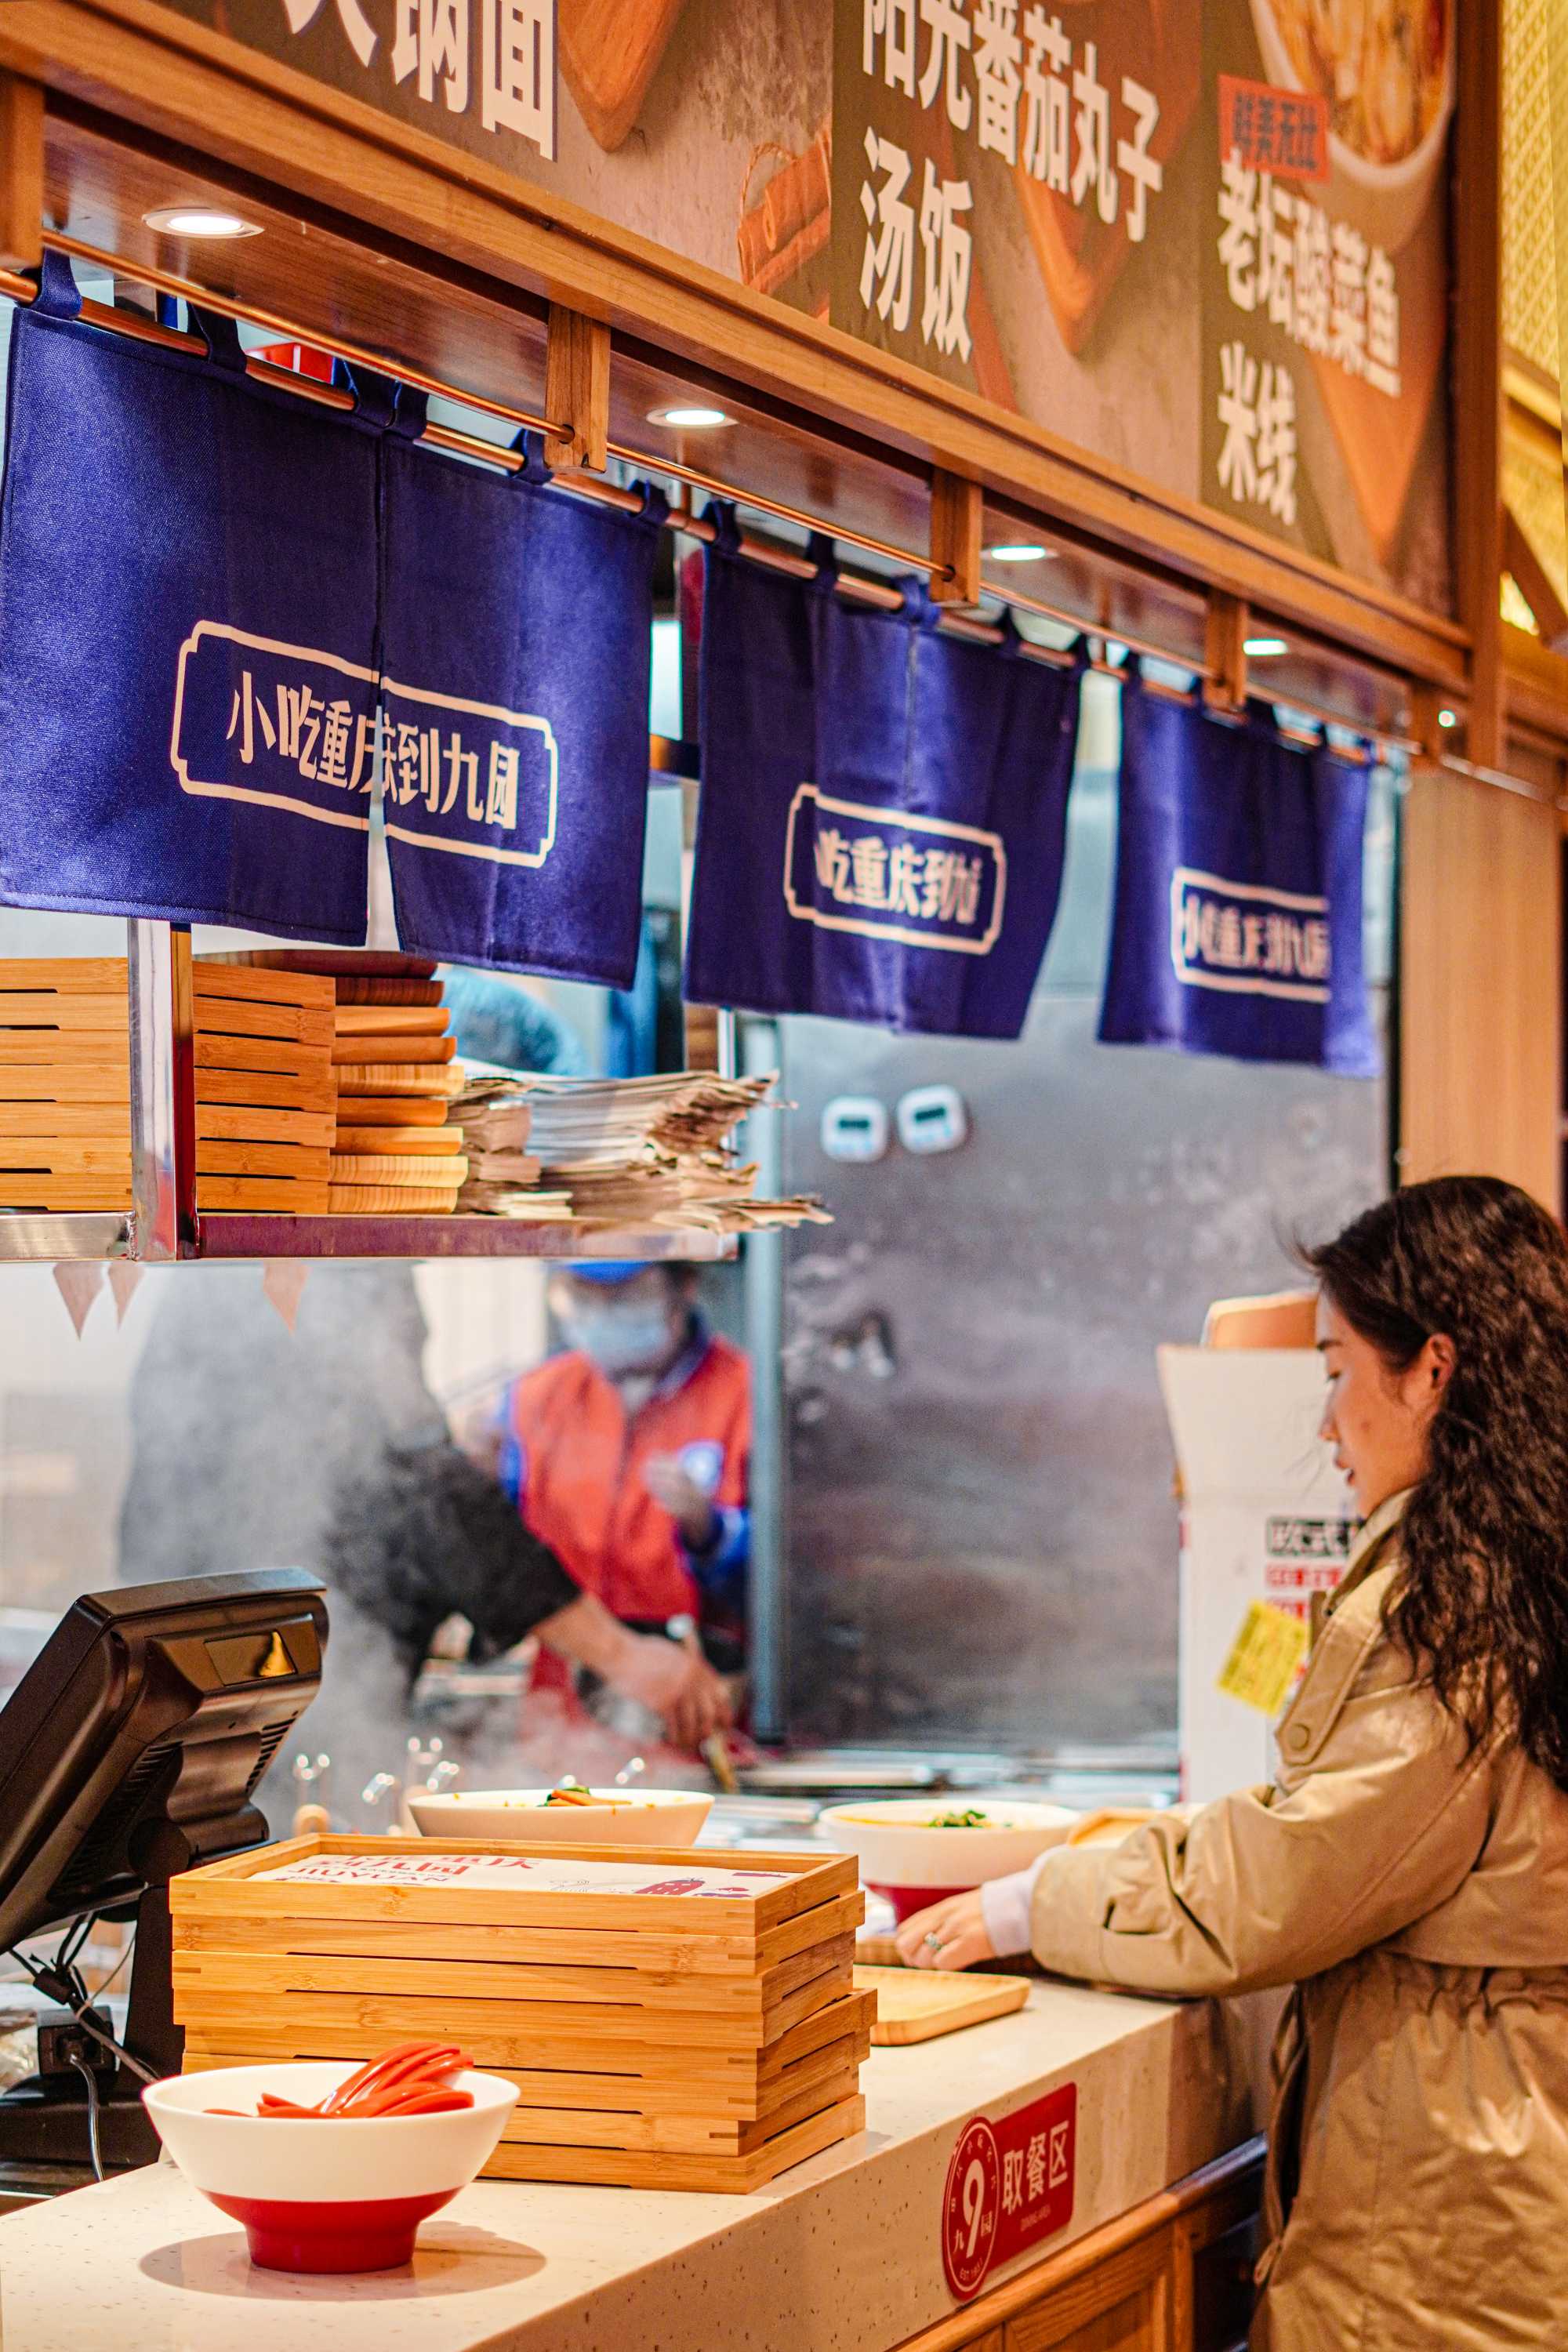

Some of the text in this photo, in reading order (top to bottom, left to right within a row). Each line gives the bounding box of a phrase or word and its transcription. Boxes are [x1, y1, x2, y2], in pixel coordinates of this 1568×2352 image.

[282, 0, 554, 160] 锅面
[863, 0, 1163, 243] 阳光番茄丸子
[859, 125, 973, 363] 汤饭
[1217, 147, 1402, 398] 老坛酸菜鱼
[1217, 341, 1298, 525] 米线
[962, 2158, 985, 2259] 9
[1001, 2120, 1069, 2216] 取餐区
